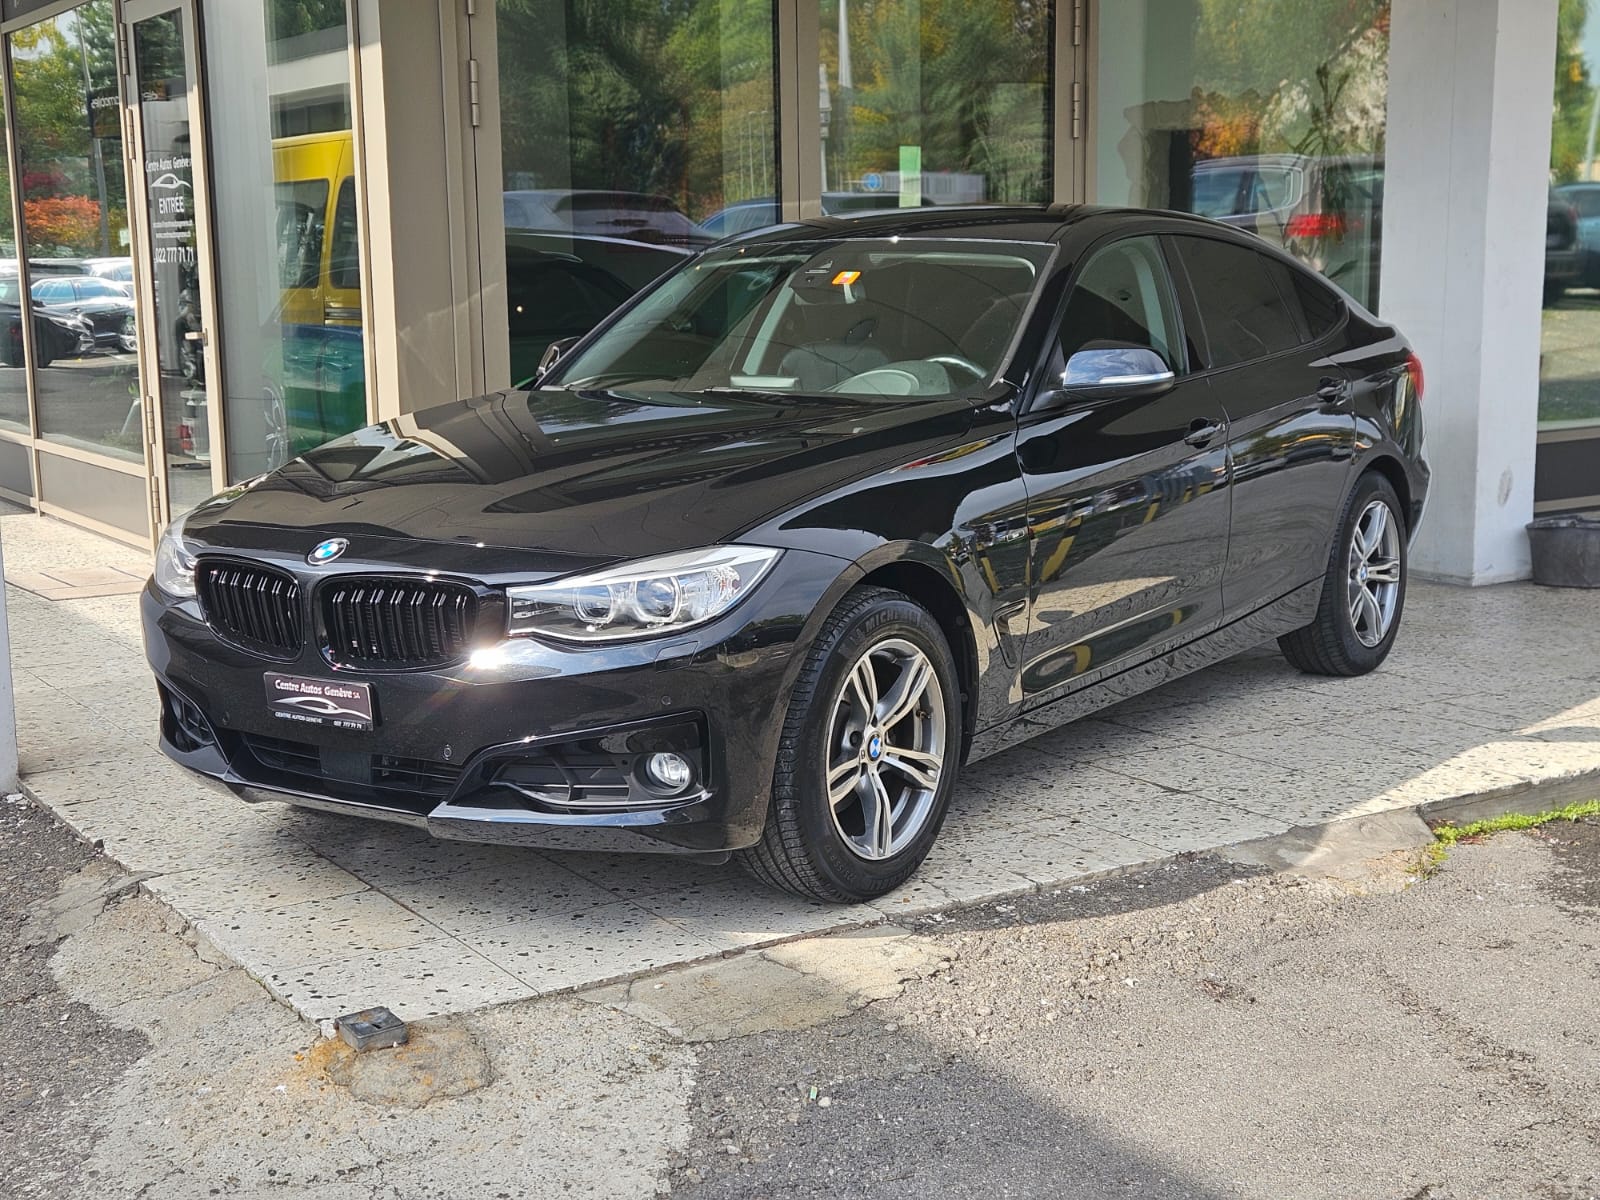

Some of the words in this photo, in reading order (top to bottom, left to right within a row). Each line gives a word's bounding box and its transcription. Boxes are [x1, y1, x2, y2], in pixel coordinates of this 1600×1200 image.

[145, 160, 158, 172] Centre
[159, 159, 172, 170] Autos
[173, 156, 189, 169] Genève
[159, 192, 184, 213] ENTRÉE
[155, 248, 166, 262] 022
[166, 247, 177, 262] 777
[178, 247, 185, 262] 71
[186, 247, 194, 262] 71
[275, 680, 299, 692] Centre
[300, 683, 322, 694] Autos
[324, 686, 353, 697] Genève
